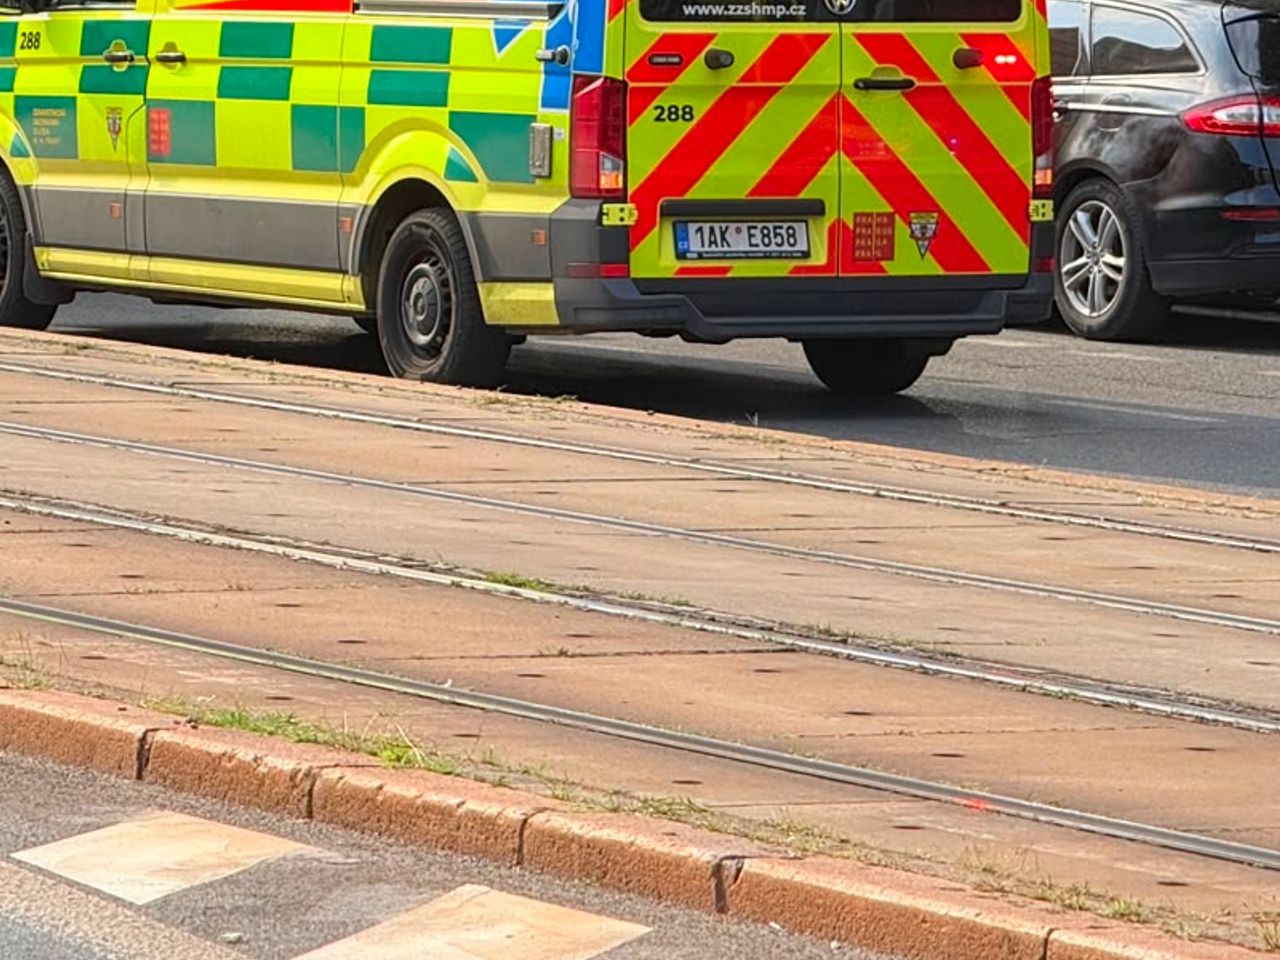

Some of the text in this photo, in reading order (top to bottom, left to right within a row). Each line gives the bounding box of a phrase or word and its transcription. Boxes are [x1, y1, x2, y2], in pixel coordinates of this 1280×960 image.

[682, 1, 807, 19] www.zzshmp.cz
[19, 31, 41, 50] 288
[653, 104, 694, 122] 288
[694, 225, 798, 249] 1AK E858
